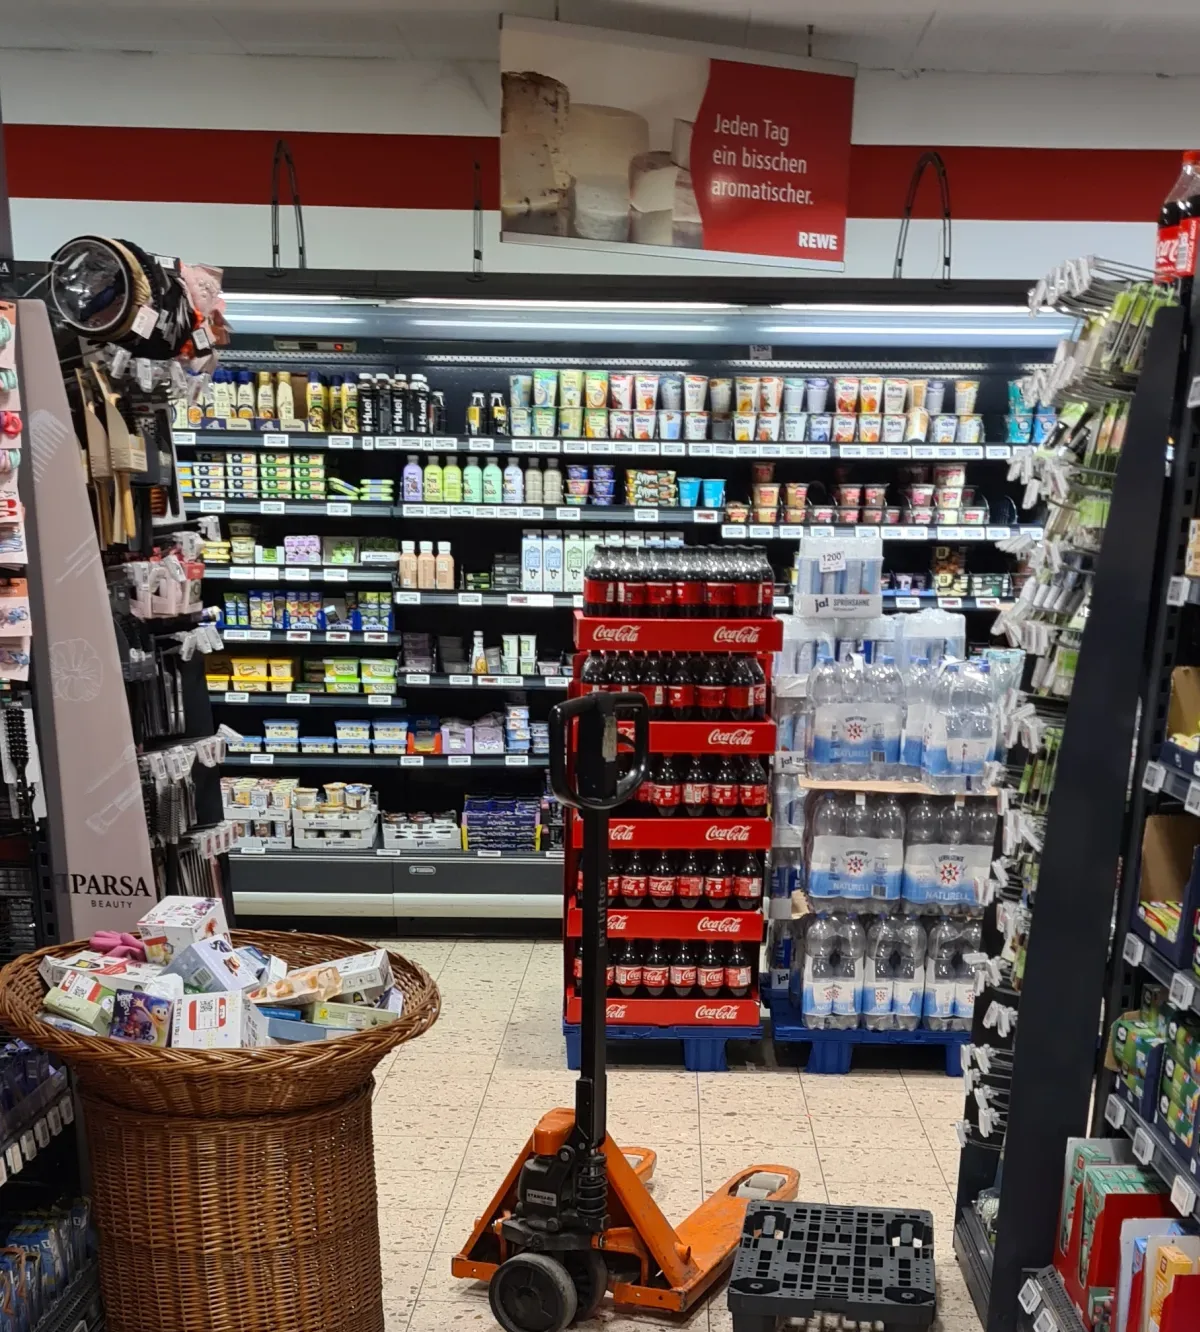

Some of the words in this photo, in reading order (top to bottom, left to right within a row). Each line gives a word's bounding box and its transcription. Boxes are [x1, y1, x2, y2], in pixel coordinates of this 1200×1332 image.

[713, 113, 758, 138] Jeden
[762, 119, 790, 147] Tag
[713, 146, 736, 166] ein
[741, 147, 807, 174] bisschen
[711, 178, 814, 206] aromatischer.
[798, 231, 838, 250] REWE
[362, 397, 373, 424] Huel
[393, 398, 403, 424] Huel
[418, 398, 427, 425] Huel
[822, 552, 842, 562] 1200
[815, 598, 829, 613] ja!
[70, 873, 152, 897] PARSA
[925, 891, 970, 901] NATURELL
[91, 900, 133, 909] BEAUTY
